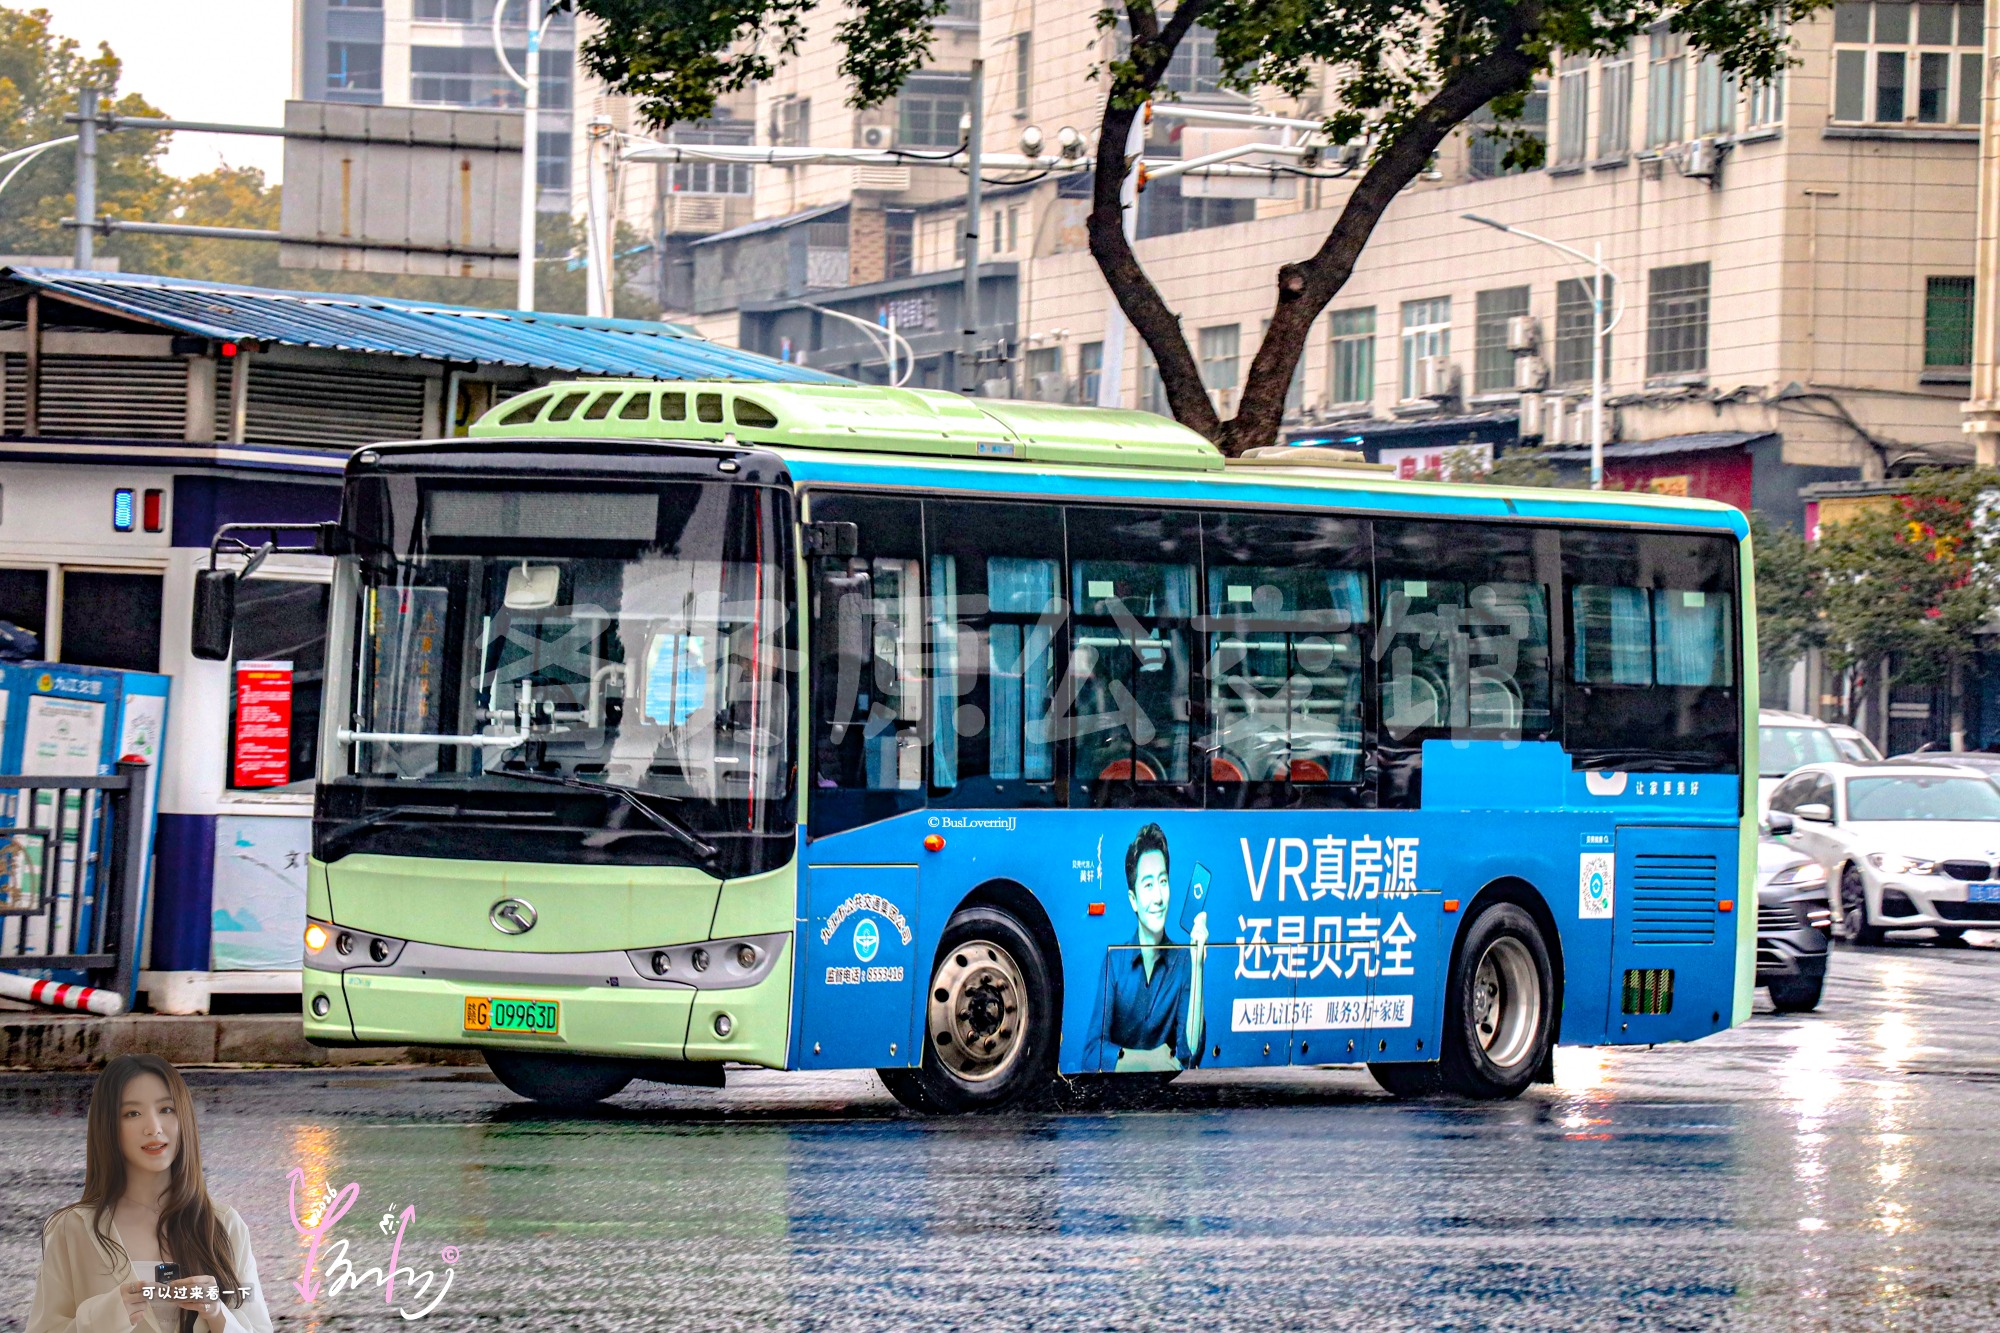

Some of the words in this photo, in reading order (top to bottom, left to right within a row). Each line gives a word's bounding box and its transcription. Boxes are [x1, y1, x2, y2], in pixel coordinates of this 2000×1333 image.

[1635, 780, 1700, 796] 让家更美好
[1239, 833, 1420, 902] VR真房源
[1233, 911, 1418, 981] 还是贝壳全
[1238, 1002, 1314, 1026] 入驻九江5年
[1325, 999, 1407, 1025] 服务3万+家庭
